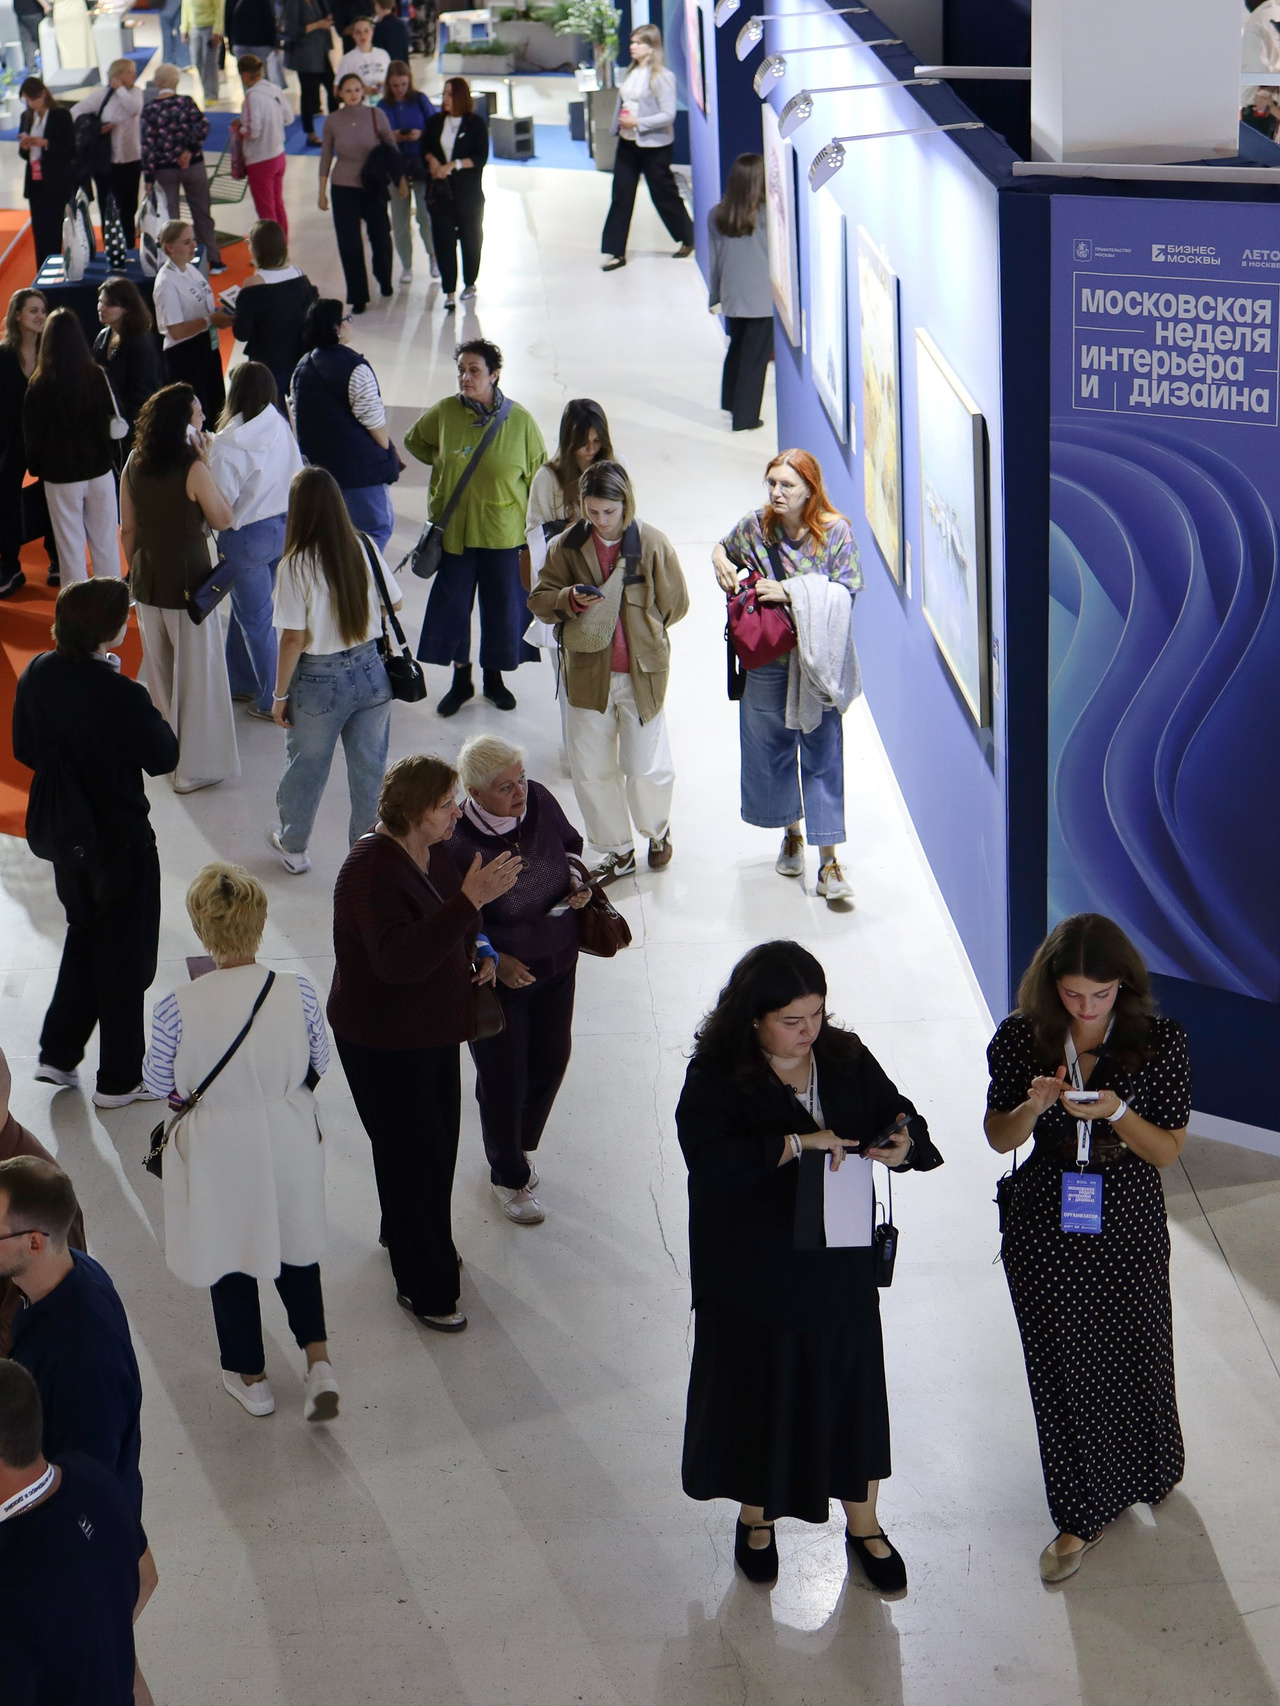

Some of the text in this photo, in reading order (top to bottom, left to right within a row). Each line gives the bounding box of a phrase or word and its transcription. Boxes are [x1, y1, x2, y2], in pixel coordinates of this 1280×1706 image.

[1167, 244, 1216, 256] БИЗНЕС
[1242, 249, 1280, 261] ЛЕТО
[1167, 255, 1221, 266] МОСКВЫ
